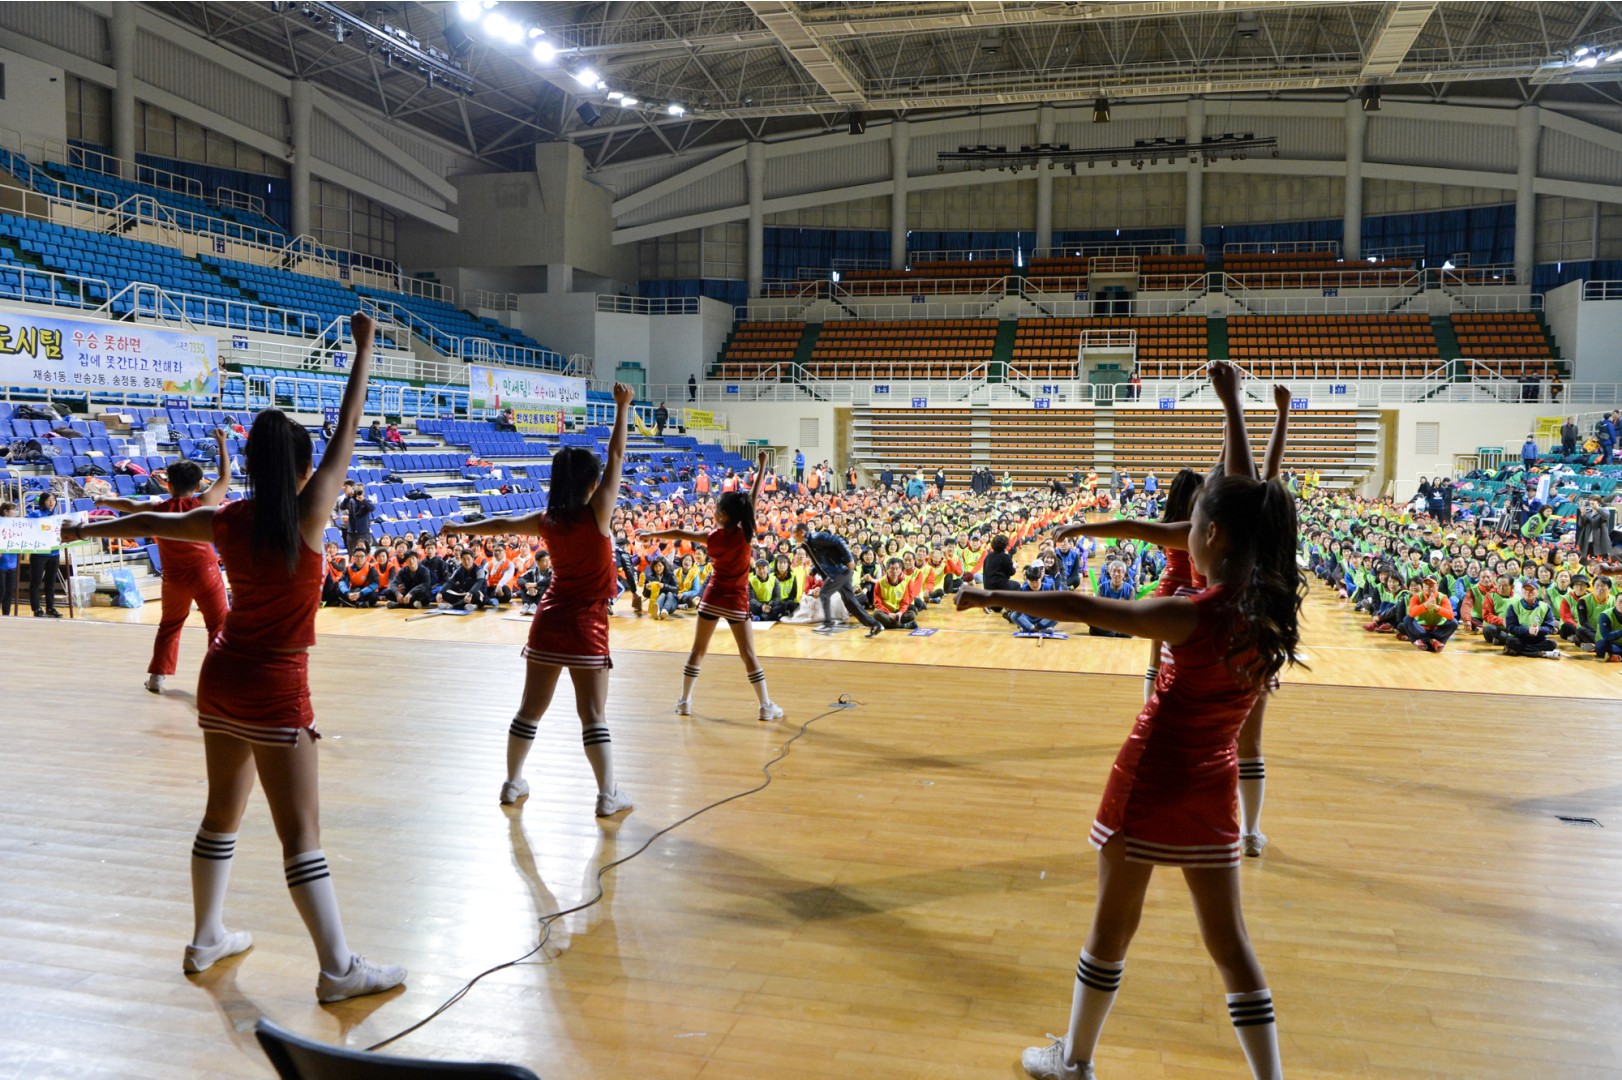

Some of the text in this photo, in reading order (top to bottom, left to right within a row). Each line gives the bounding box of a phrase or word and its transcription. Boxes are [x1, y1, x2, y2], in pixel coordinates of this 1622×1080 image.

[73, 331, 141, 353] 우승 못하면
[189, 342, 206, 354] 7330
[79, 352, 183, 374] 집에 못간다고 전해라
[33, 369, 70, 383] 재송1동,
[73, 372, 109, 386] 반송2동,
[113, 375, 141, 388] 송정동,
